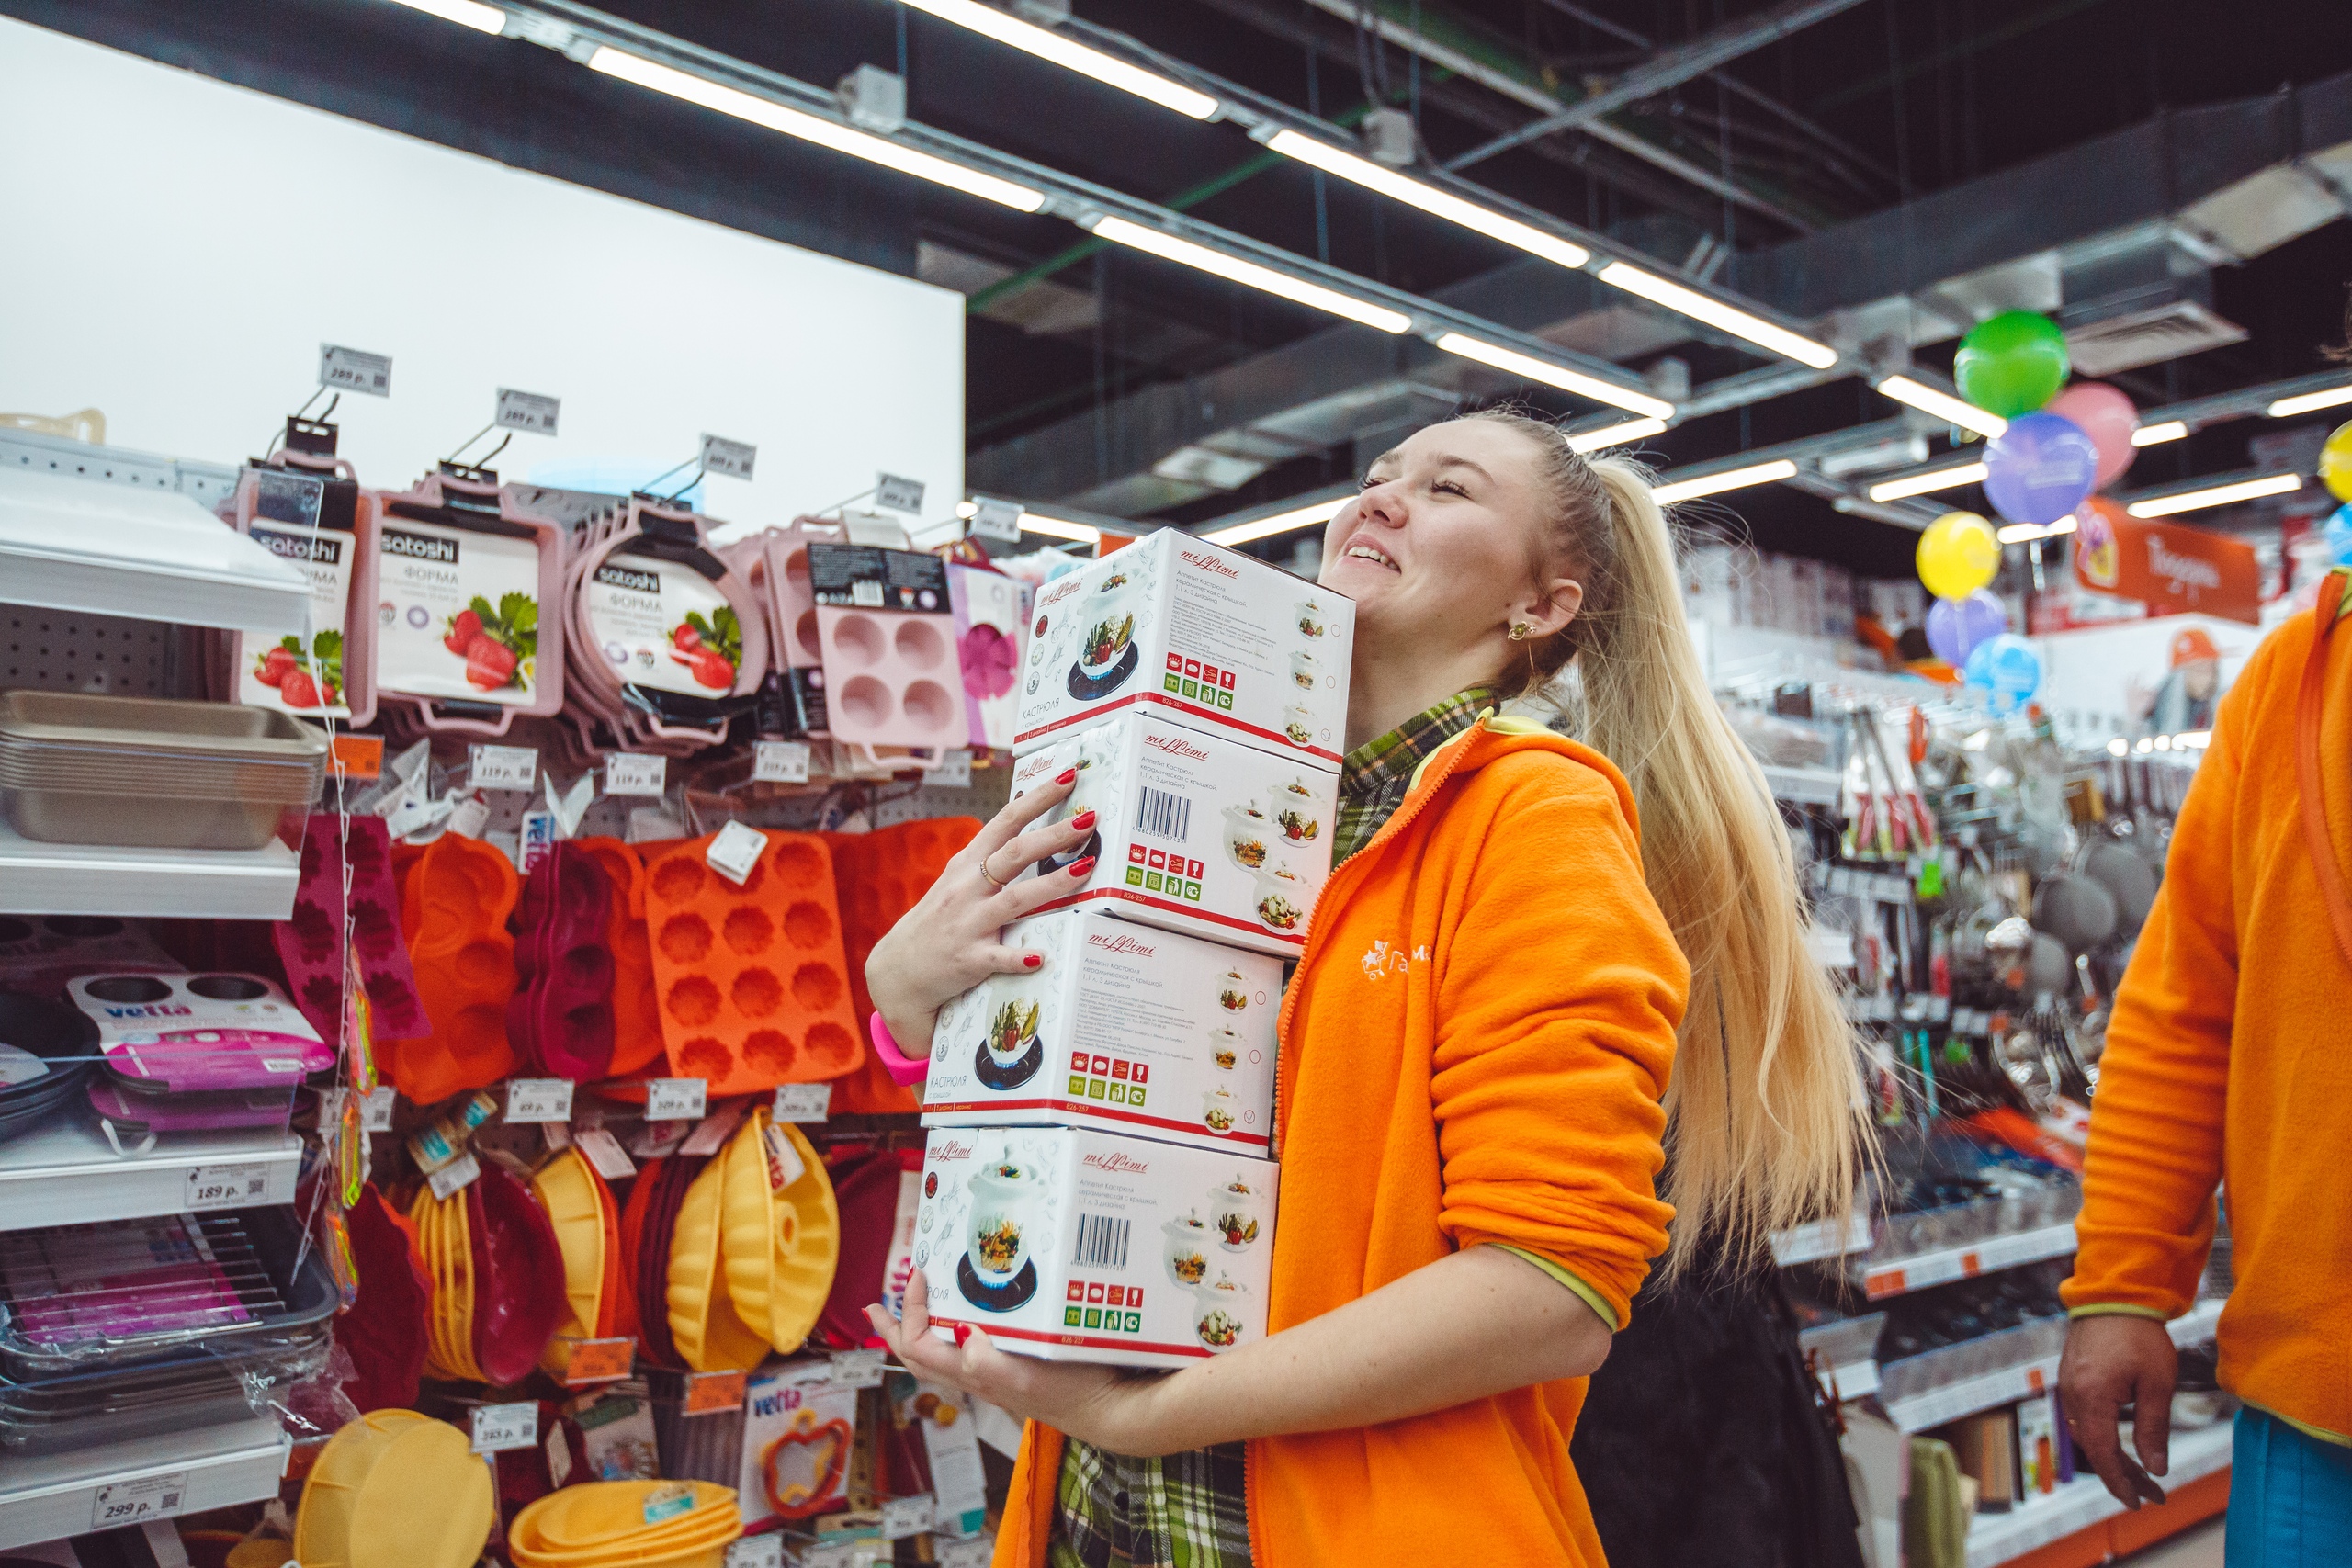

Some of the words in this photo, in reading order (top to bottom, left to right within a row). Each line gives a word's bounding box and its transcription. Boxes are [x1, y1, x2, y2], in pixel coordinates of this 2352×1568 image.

[381, 535, 454, 562] satoshi
[404, 565, 458, 584] ФОРМА
[599, 567, 659, 592] satoshi
[1200, 579, 1226, 592] Кастрюля
[610, 592, 663, 613] ФОРМА
[1023, 697, 1059, 719] КАСТРЮЛЯ
[1162, 697, 1182, 708] 826-257
[1166, 763, 1194, 776] Кастрюля
[1124, 892, 1146, 902] 826-257
[1111, 963, 1141, 974] Кастрюля
[930, 1075, 967, 1088] КАСТРЮЛЯ
[1066, 1102, 1090, 1112] 826-257
[105, 1502, 135, 1518] 299
